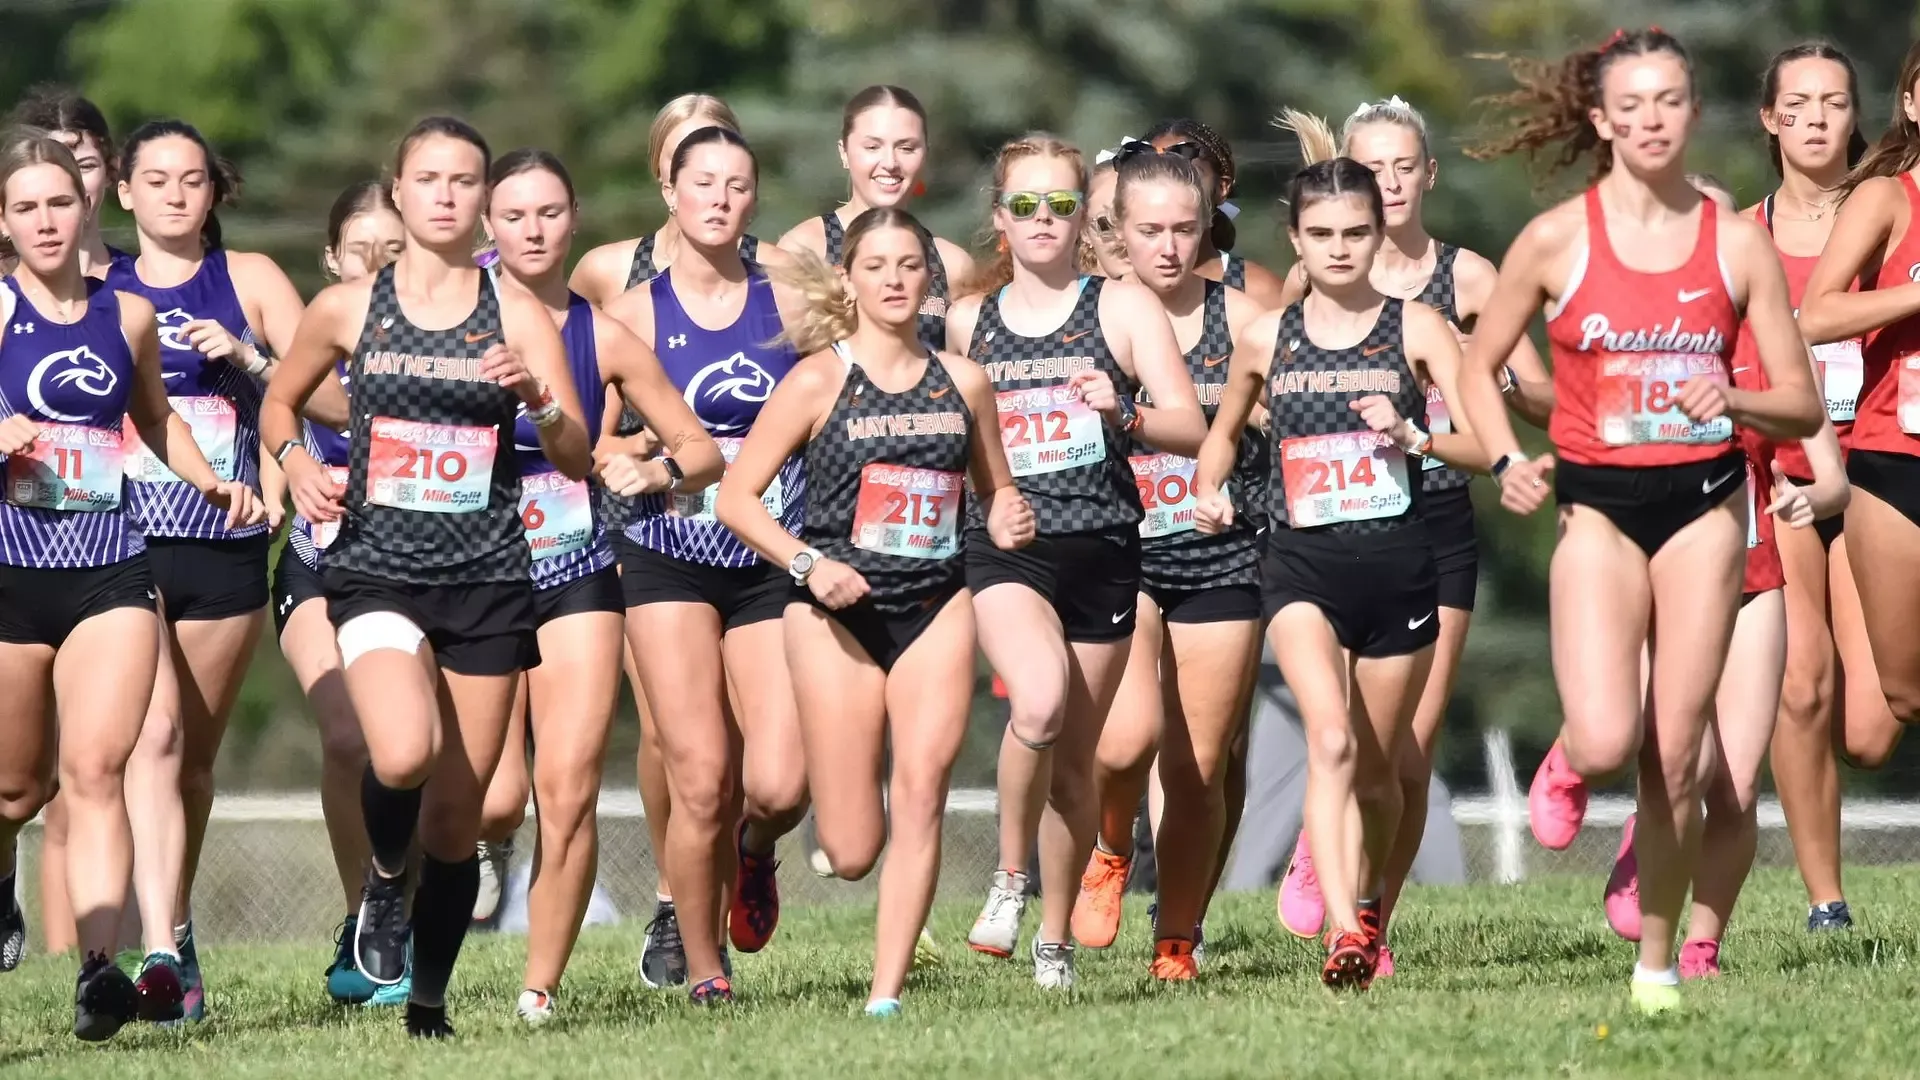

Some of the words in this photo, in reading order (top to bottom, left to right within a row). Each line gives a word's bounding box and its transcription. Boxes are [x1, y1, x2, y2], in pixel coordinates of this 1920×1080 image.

[1577, 313, 1724, 352] Presidents
[981, 356, 1095, 383] AYNESBURG
[1271, 369, 1400, 397] WAYNESBURG
[847, 411, 967, 441] WAYNESBURG
[1004, 410, 1071, 448] 212
[55, 448, 82, 480] 11
[392, 446, 467, 483] 210
[1037, 442, 1096, 464] MileSplit
[1308, 456, 1377, 495] 214
[63, 487, 114, 507] MileSplit
[421, 488, 482, 505] MileSplit
[883, 492, 944, 528] 213
[1340, 493, 1402, 512] MileSplit
[530, 528, 586, 551] MileSplit
[907, 534, 951, 551] MileSplit
